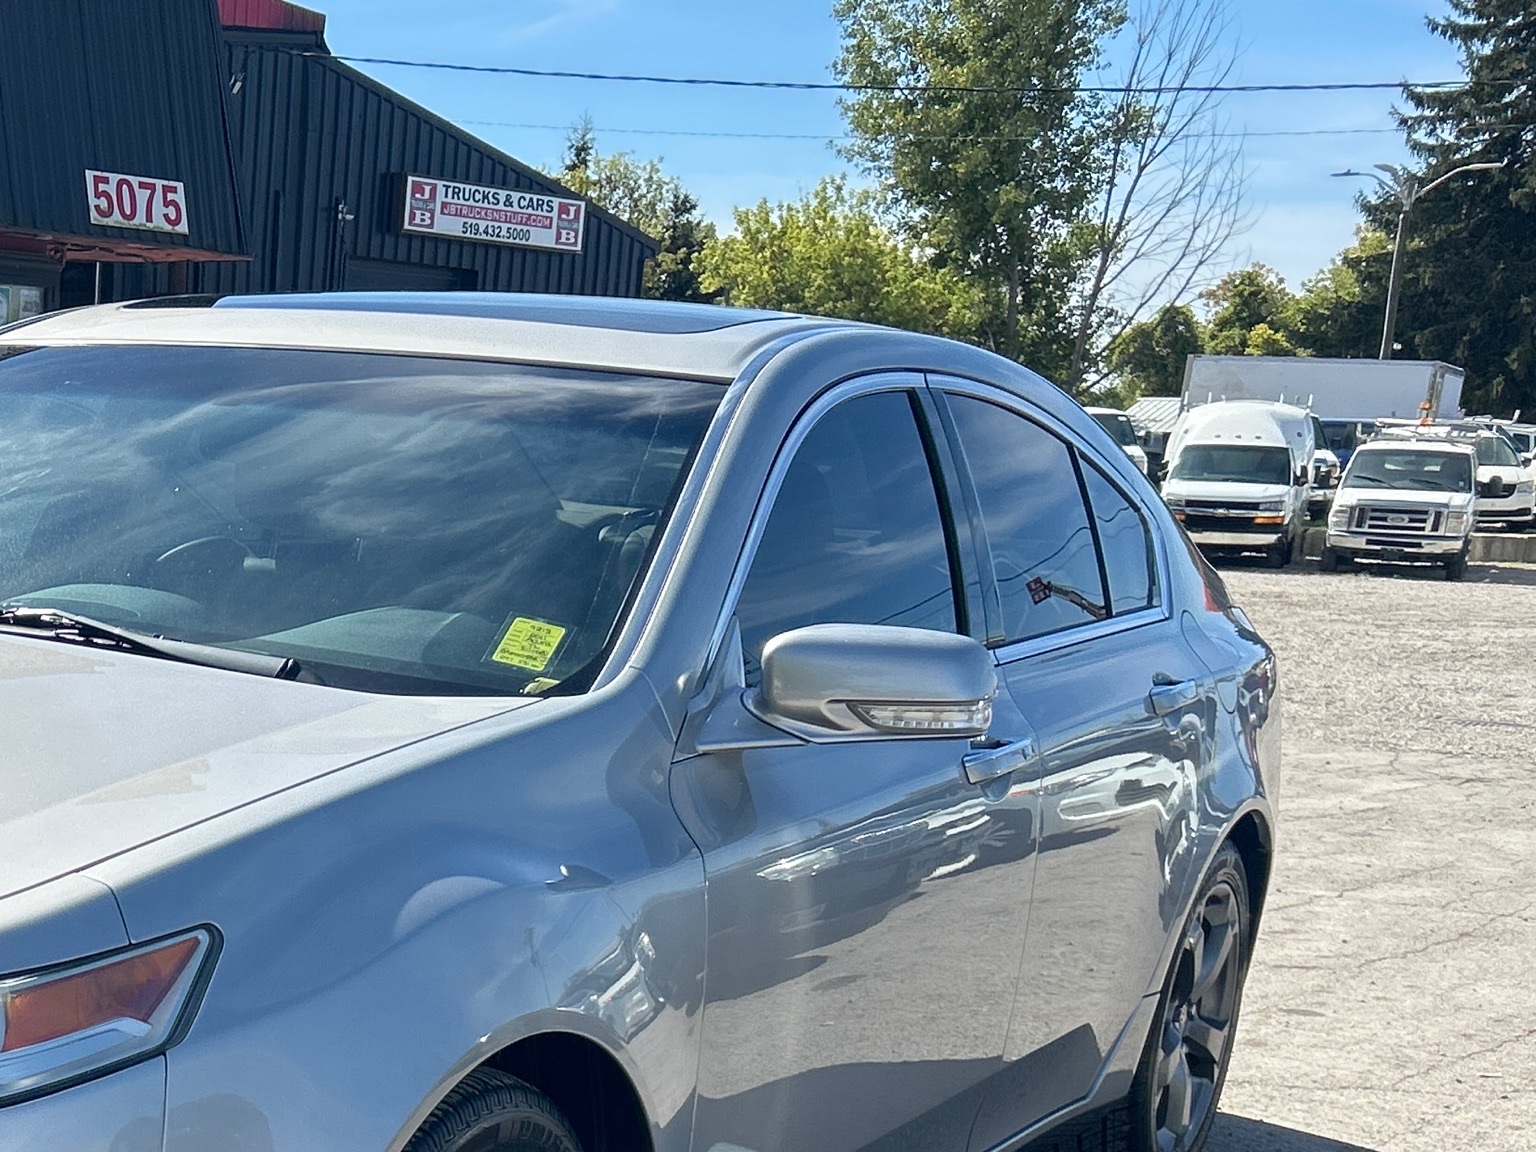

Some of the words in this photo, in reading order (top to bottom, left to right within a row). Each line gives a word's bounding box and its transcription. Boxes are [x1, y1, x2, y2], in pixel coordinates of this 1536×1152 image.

[92, 174, 182, 228] 5075
[414, 185, 433, 200] J
[442, 184, 500, 206] TRUCKS
[503, 193, 514, 209] &
[517, 195, 554, 214] CARS
[412, 210, 432, 226] B
[443, 203, 551, 228] JBTRUCKSNSTUFF.COM
[560, 206, 577, 221] J
[461, 221, 531, 243] 519.432.5000
[558, 229, 576, 244] B
